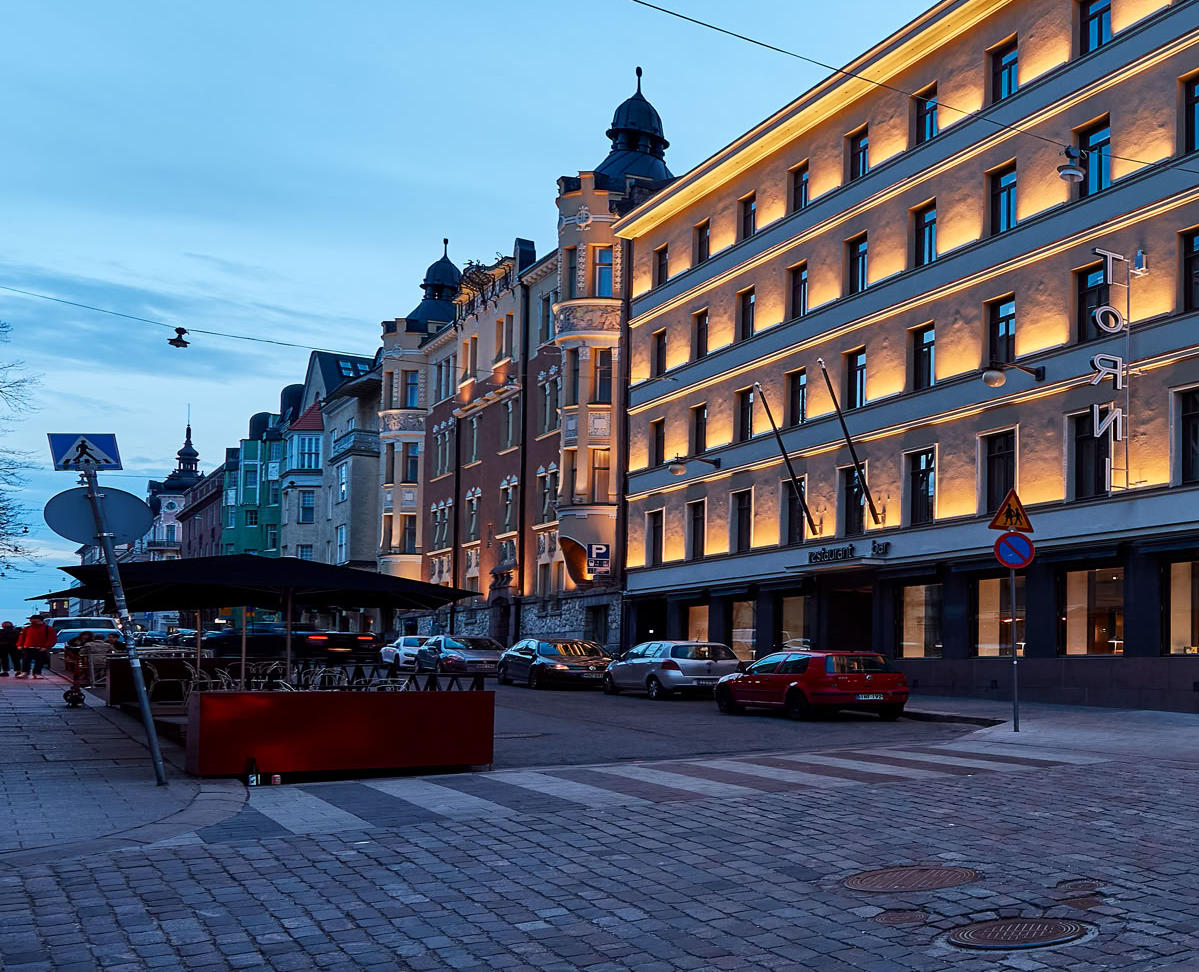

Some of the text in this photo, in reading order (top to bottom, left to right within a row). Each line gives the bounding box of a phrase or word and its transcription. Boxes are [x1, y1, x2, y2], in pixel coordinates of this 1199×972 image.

[592, 545, 606, 558] P
[808, 540, 892, 563] restaurant bar
